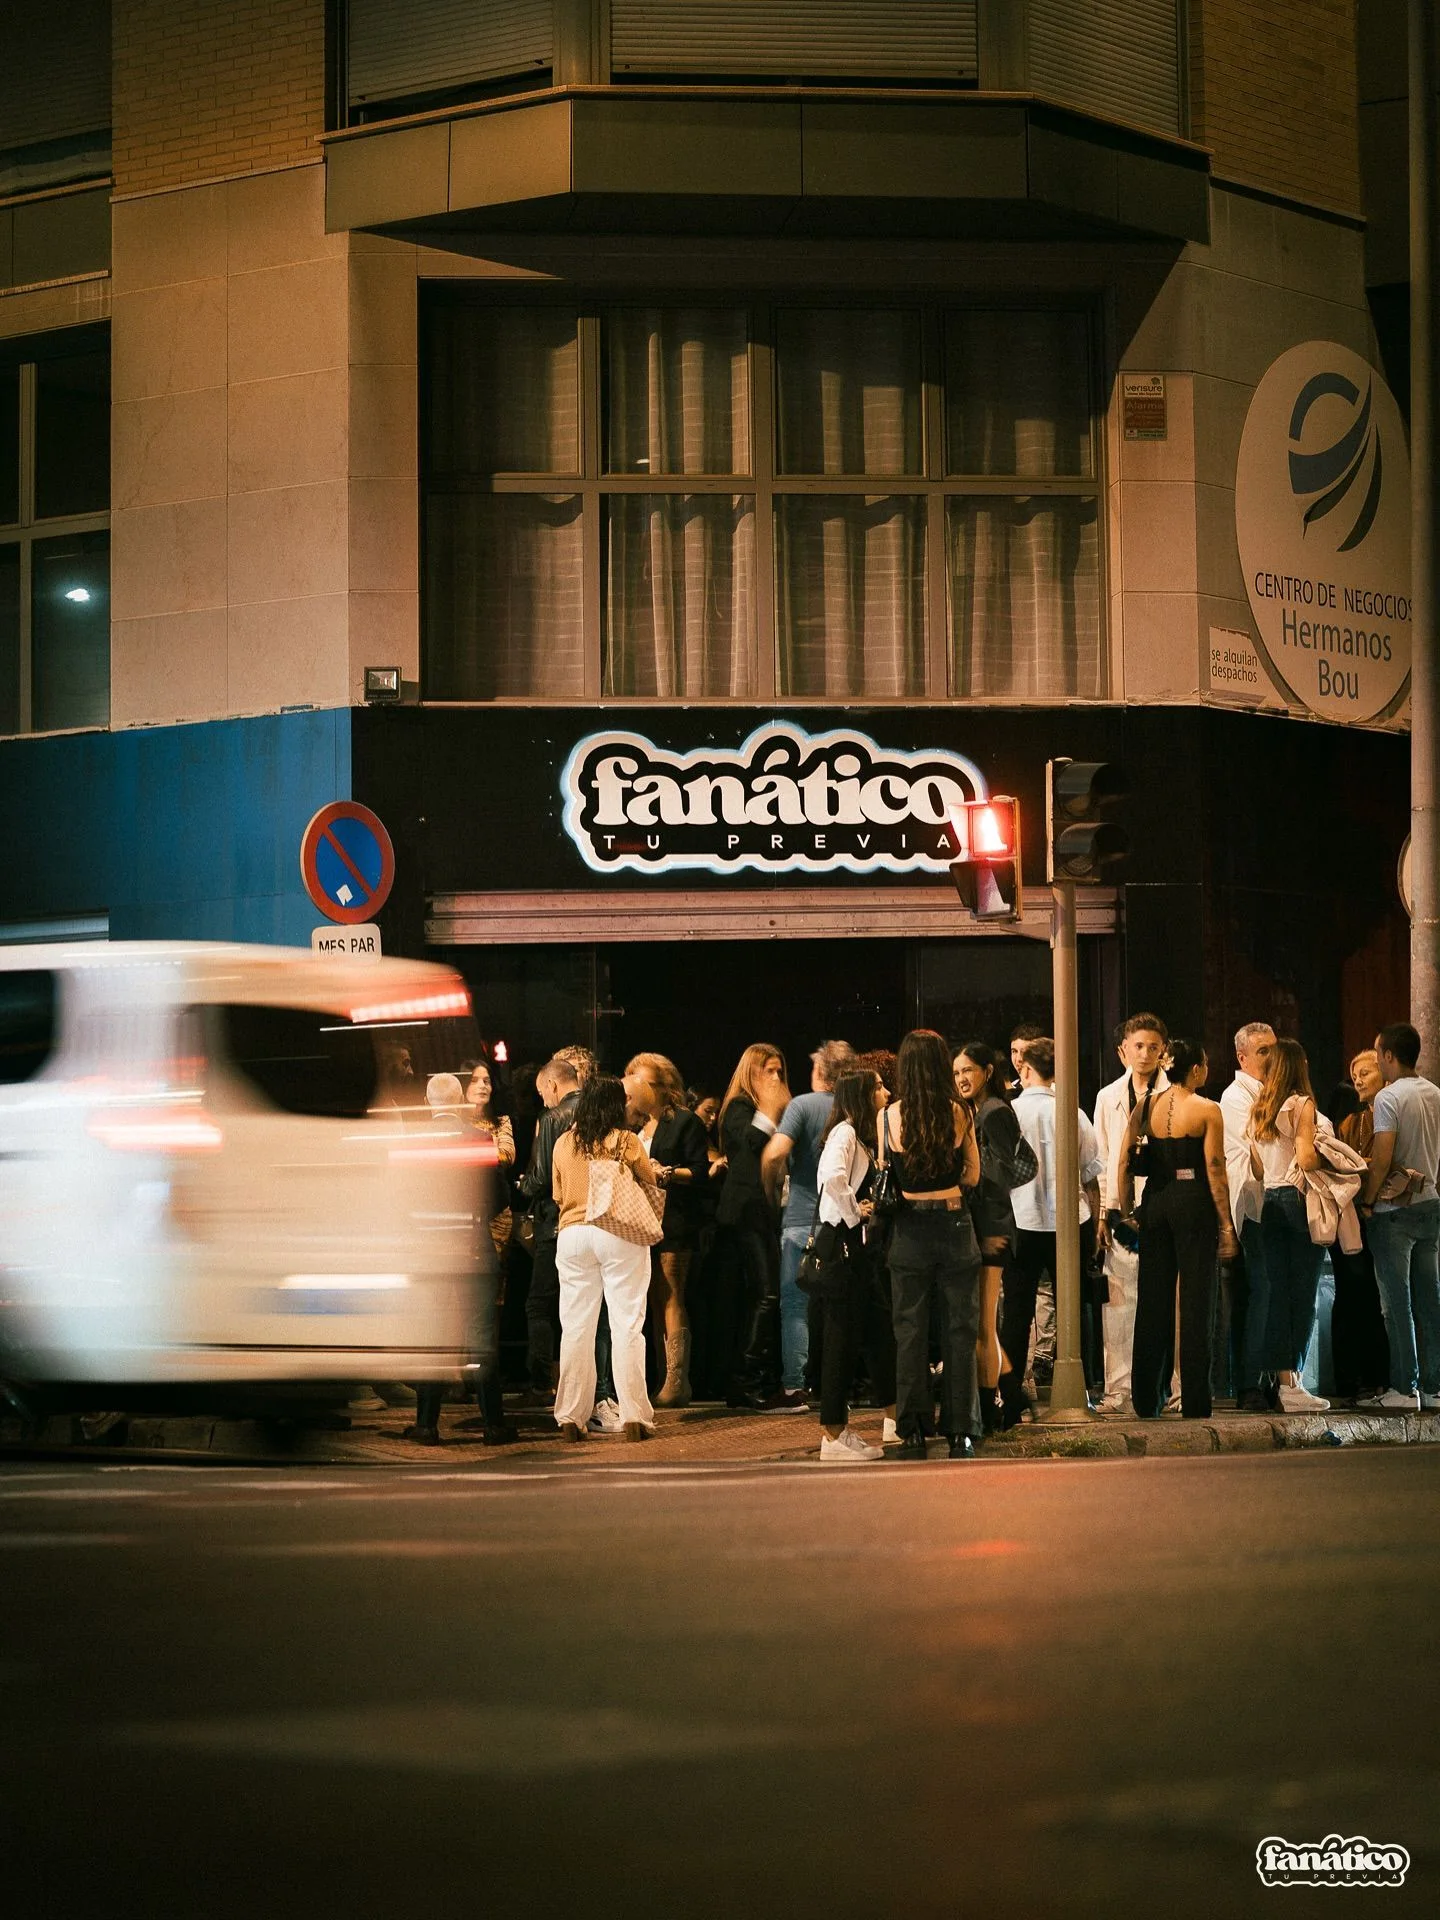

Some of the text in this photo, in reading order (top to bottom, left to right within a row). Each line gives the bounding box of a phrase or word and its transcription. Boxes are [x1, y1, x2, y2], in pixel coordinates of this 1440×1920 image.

[1255, 572, 1313, 605] CENTRO
[1317, 582, 1337, 609] DE
[1282, 608, 1392, 662] Hermanos
[1211, 648, 1258, 667] se alquilan
[1211, 663, 1258, 683] despachos
[1318, 659, 1359, 700] Bou
[591, 749, 965, 826] fanático
[350, 937, 374, 952] PAR
